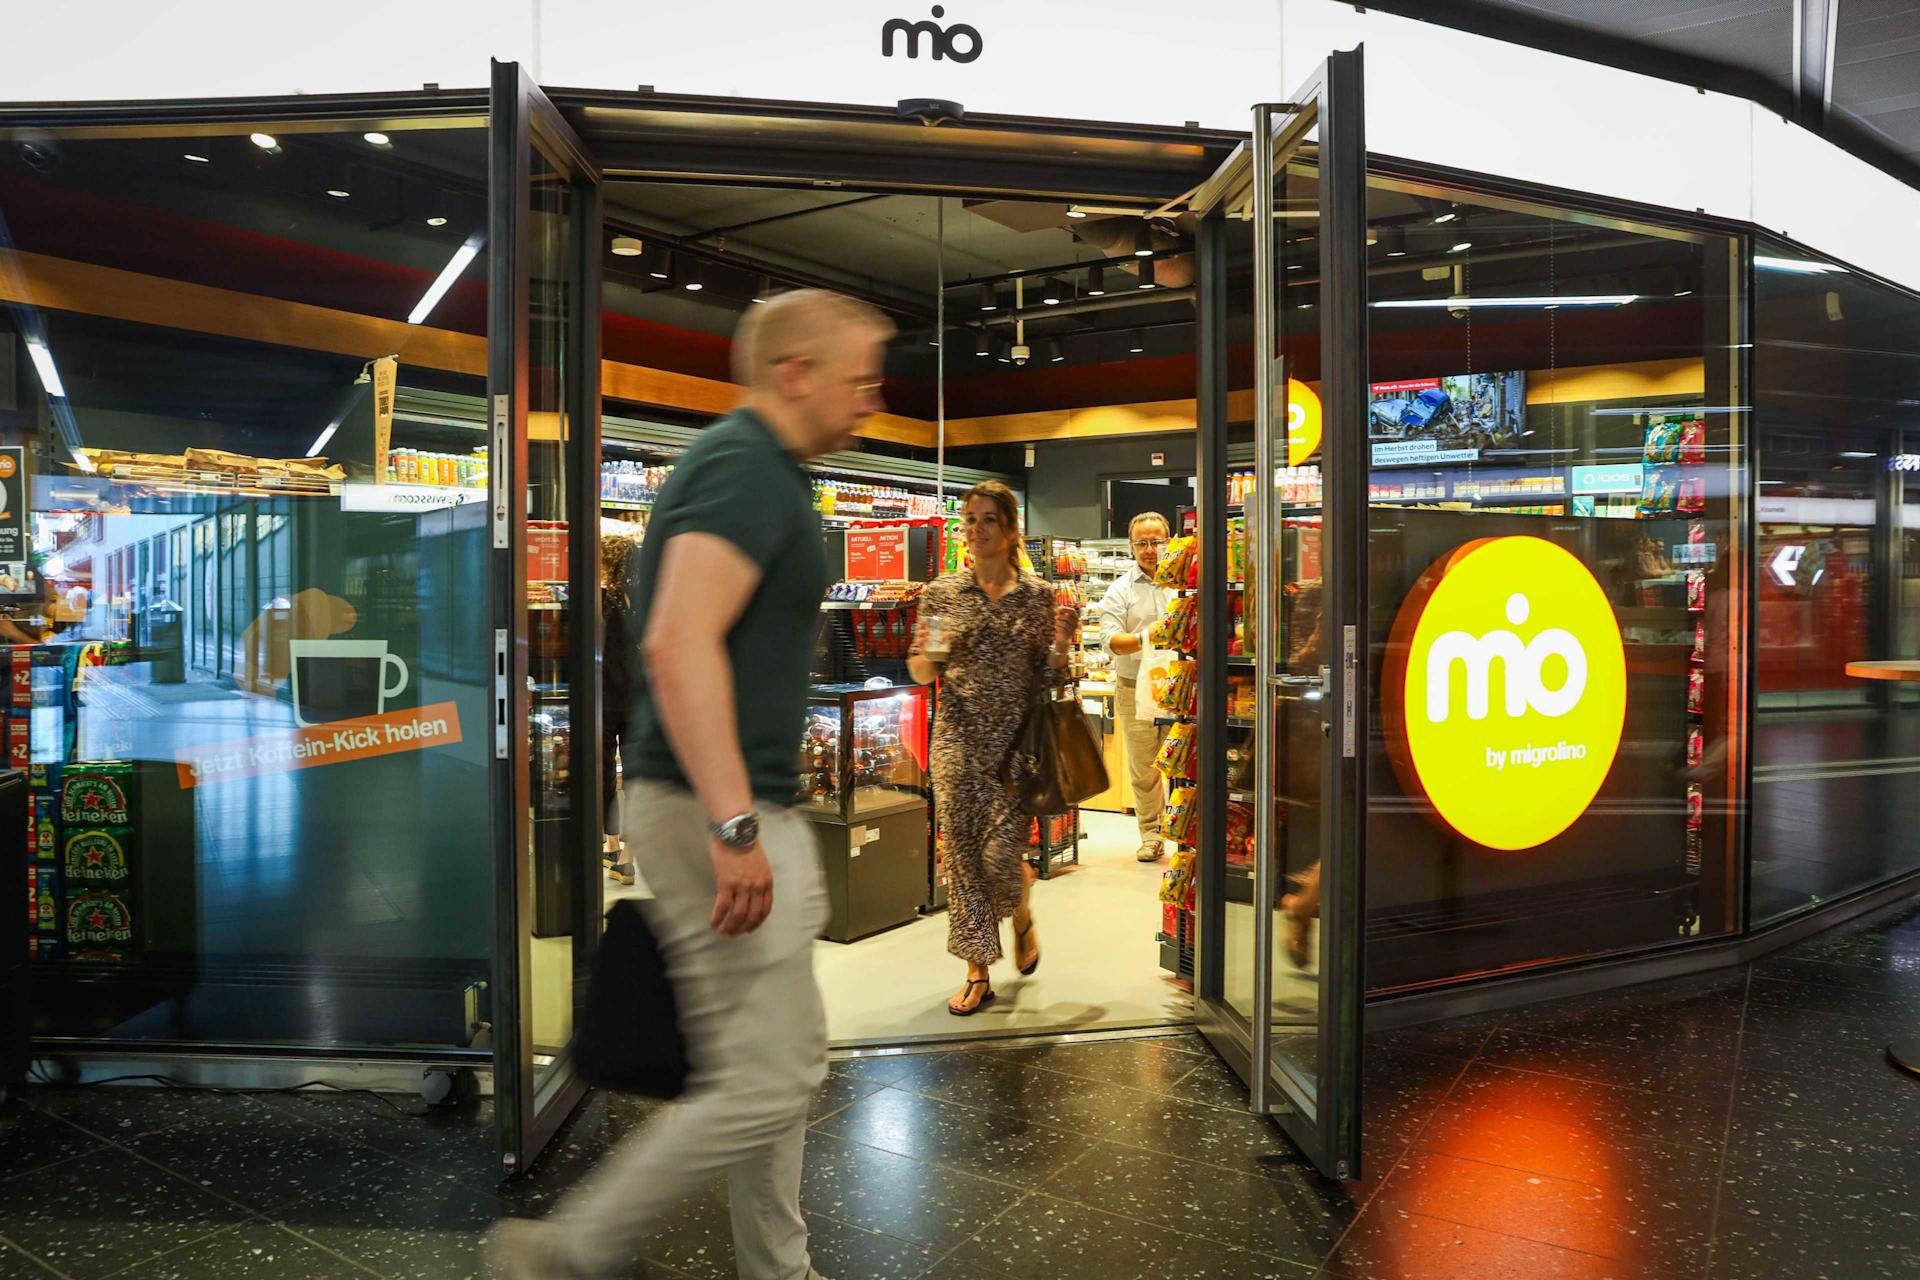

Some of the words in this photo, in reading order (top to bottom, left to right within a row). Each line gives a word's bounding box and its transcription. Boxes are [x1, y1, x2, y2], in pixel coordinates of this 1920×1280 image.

[882, 4, 983, 64] mio
[1410, 443, 1435, 451] drohen
[1374, 456, 1408, 464] deswegen
[1410, 454, 1439, 462] heftigen
[1441, 452, 1477, 460] Unwetter.
[0, 527, 19, 537] ung
[1427, 592, 1588, 723] mio
[14, 670, 31, 686] +2
[11, 744, 28, 759] +2
[189, 752, 244, 778] Jetzt
[250, 727, 381, 766] Koffein-Kick
[386, 717, 448, 744] holen
[1486, 746, 1507, 771] by
[1511, 741, 1587, 768] migrolino
[64, 864, 128, 880] Heineken
